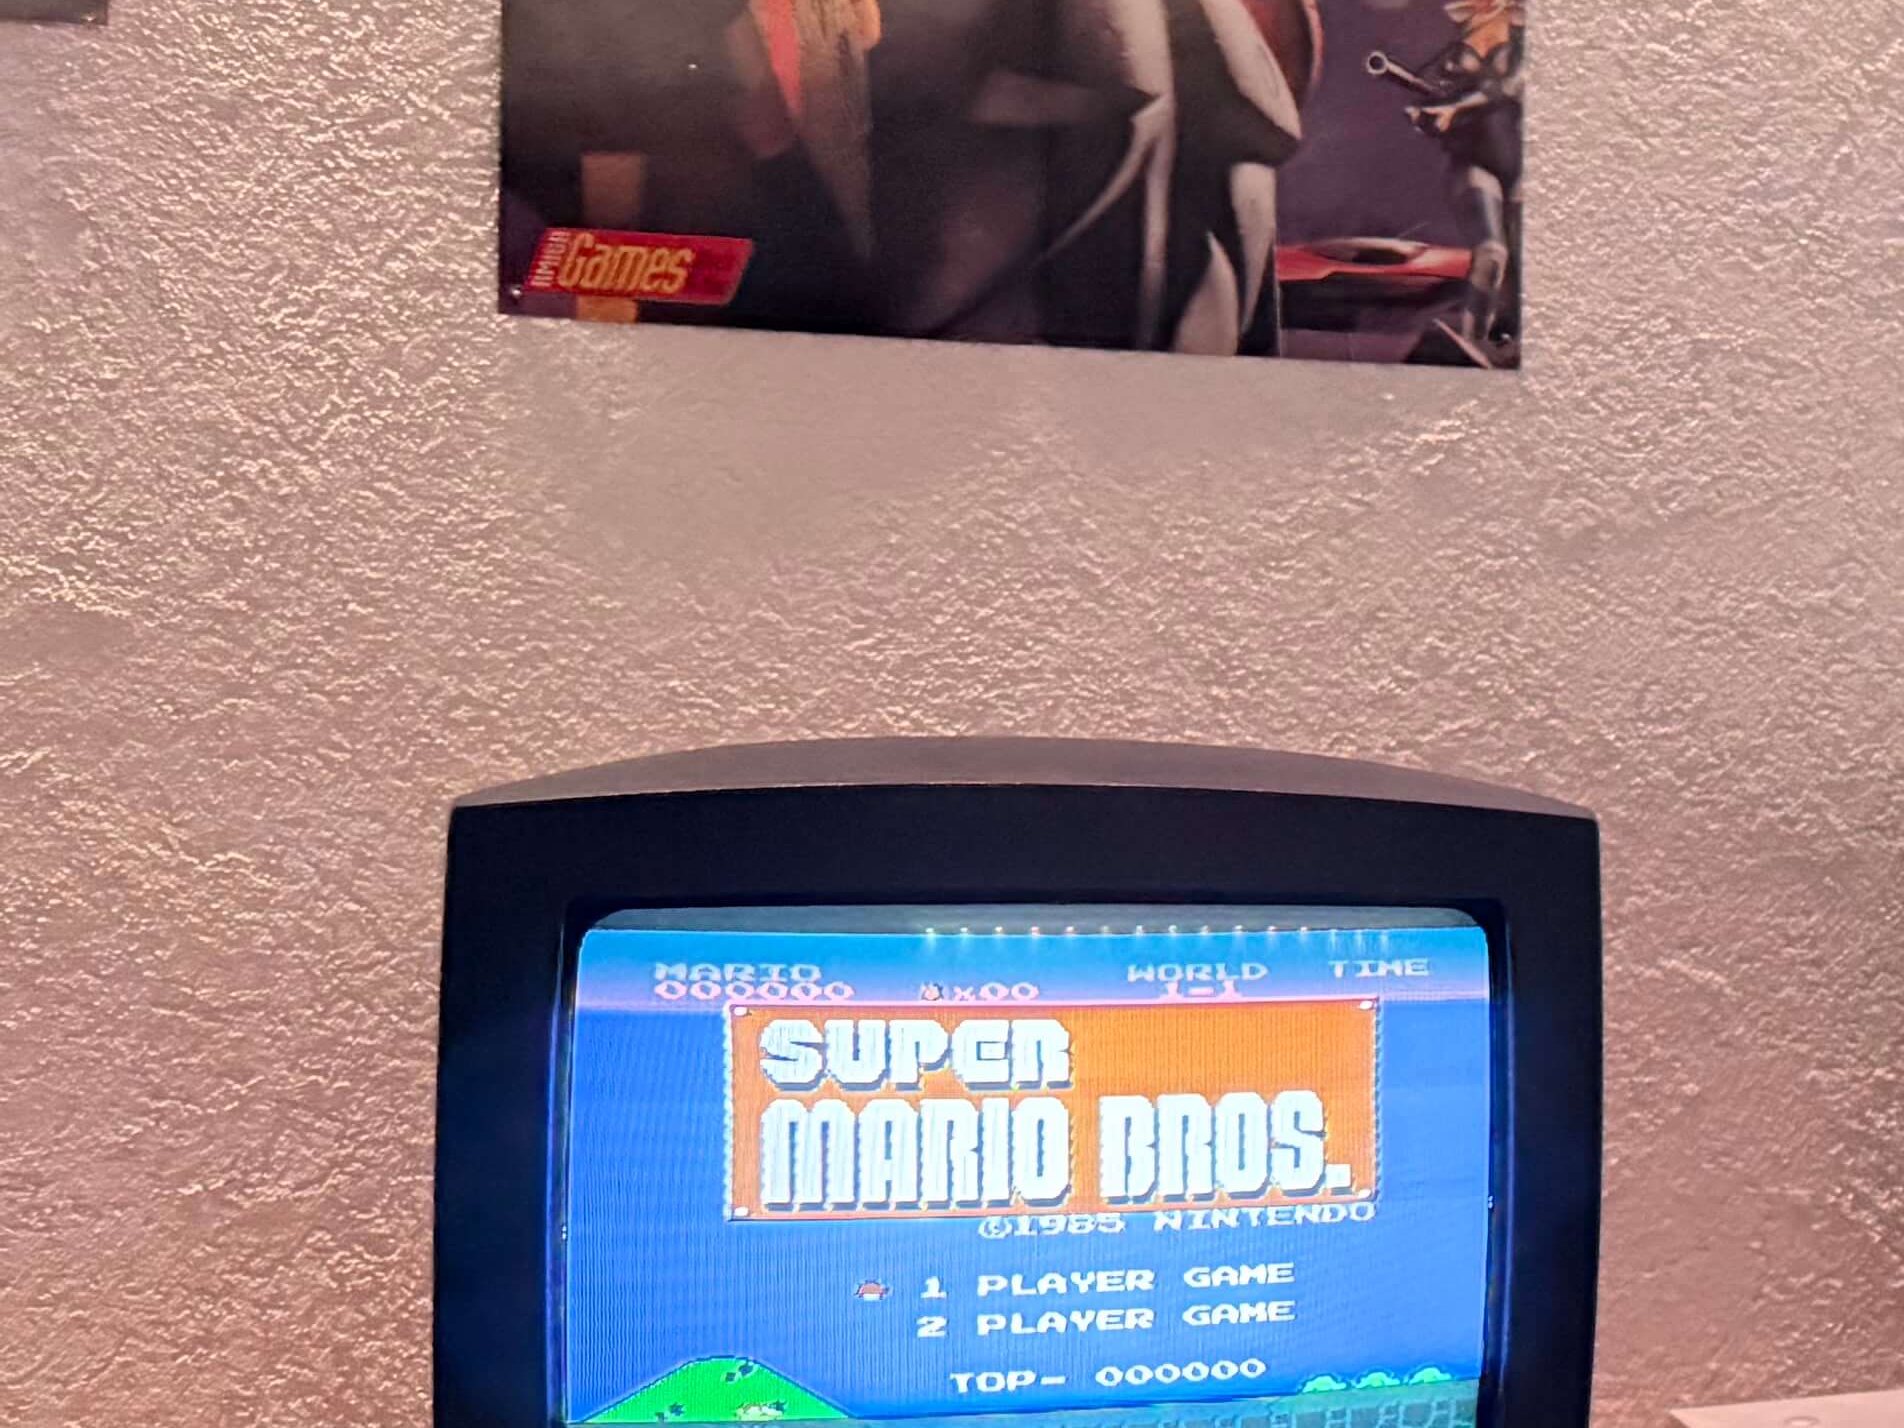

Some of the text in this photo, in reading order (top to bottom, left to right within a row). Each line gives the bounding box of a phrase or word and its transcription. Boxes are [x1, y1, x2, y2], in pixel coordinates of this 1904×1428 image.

[557, 232, 696, 294] Games
[654, 962, 822, 983] MARIO
[1127, 963, 1269, 982] WORLD
[1329, 958, 1430, 978] TIME
[653, 981, 856, 1001] 000000
[760, 1019, 1075, 1091] SUPER
[760, 1097, 1074, 1212] MARIO
[1153, 1202, 1377, 1233] NINTENDO
[920, 1262, 1297, 1299] 1 PLAYER GAME
[916, 1299, 1297, 1339] 2 PLAYER GAME
[1094, 1357, 1267, 1388] 000000
